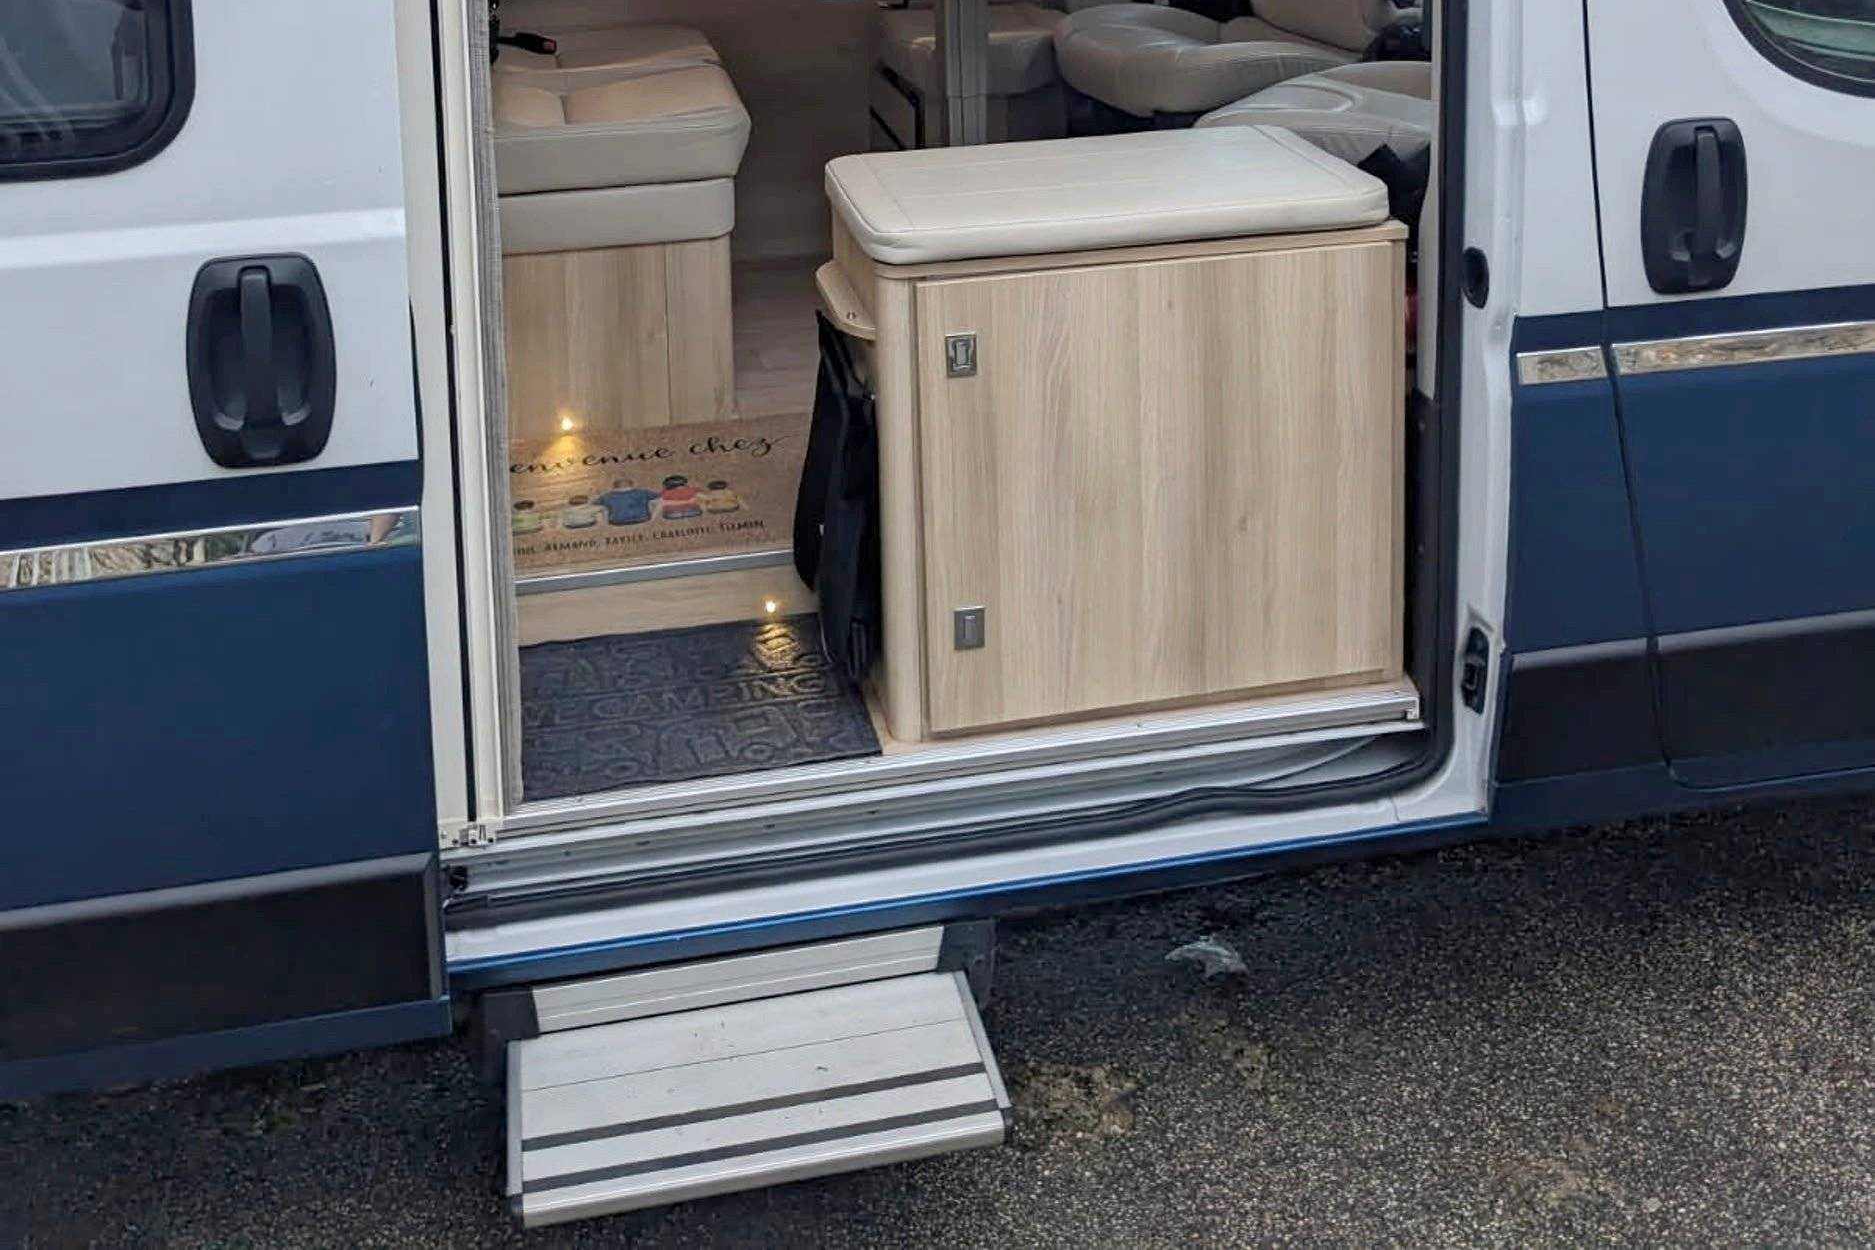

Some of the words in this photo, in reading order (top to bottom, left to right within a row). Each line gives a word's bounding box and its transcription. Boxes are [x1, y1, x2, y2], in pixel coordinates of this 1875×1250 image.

[510, 447, 675, 474] envenue
[688, 435, 791, 459] chez
[593, 672, 827, 718] CAMPING
